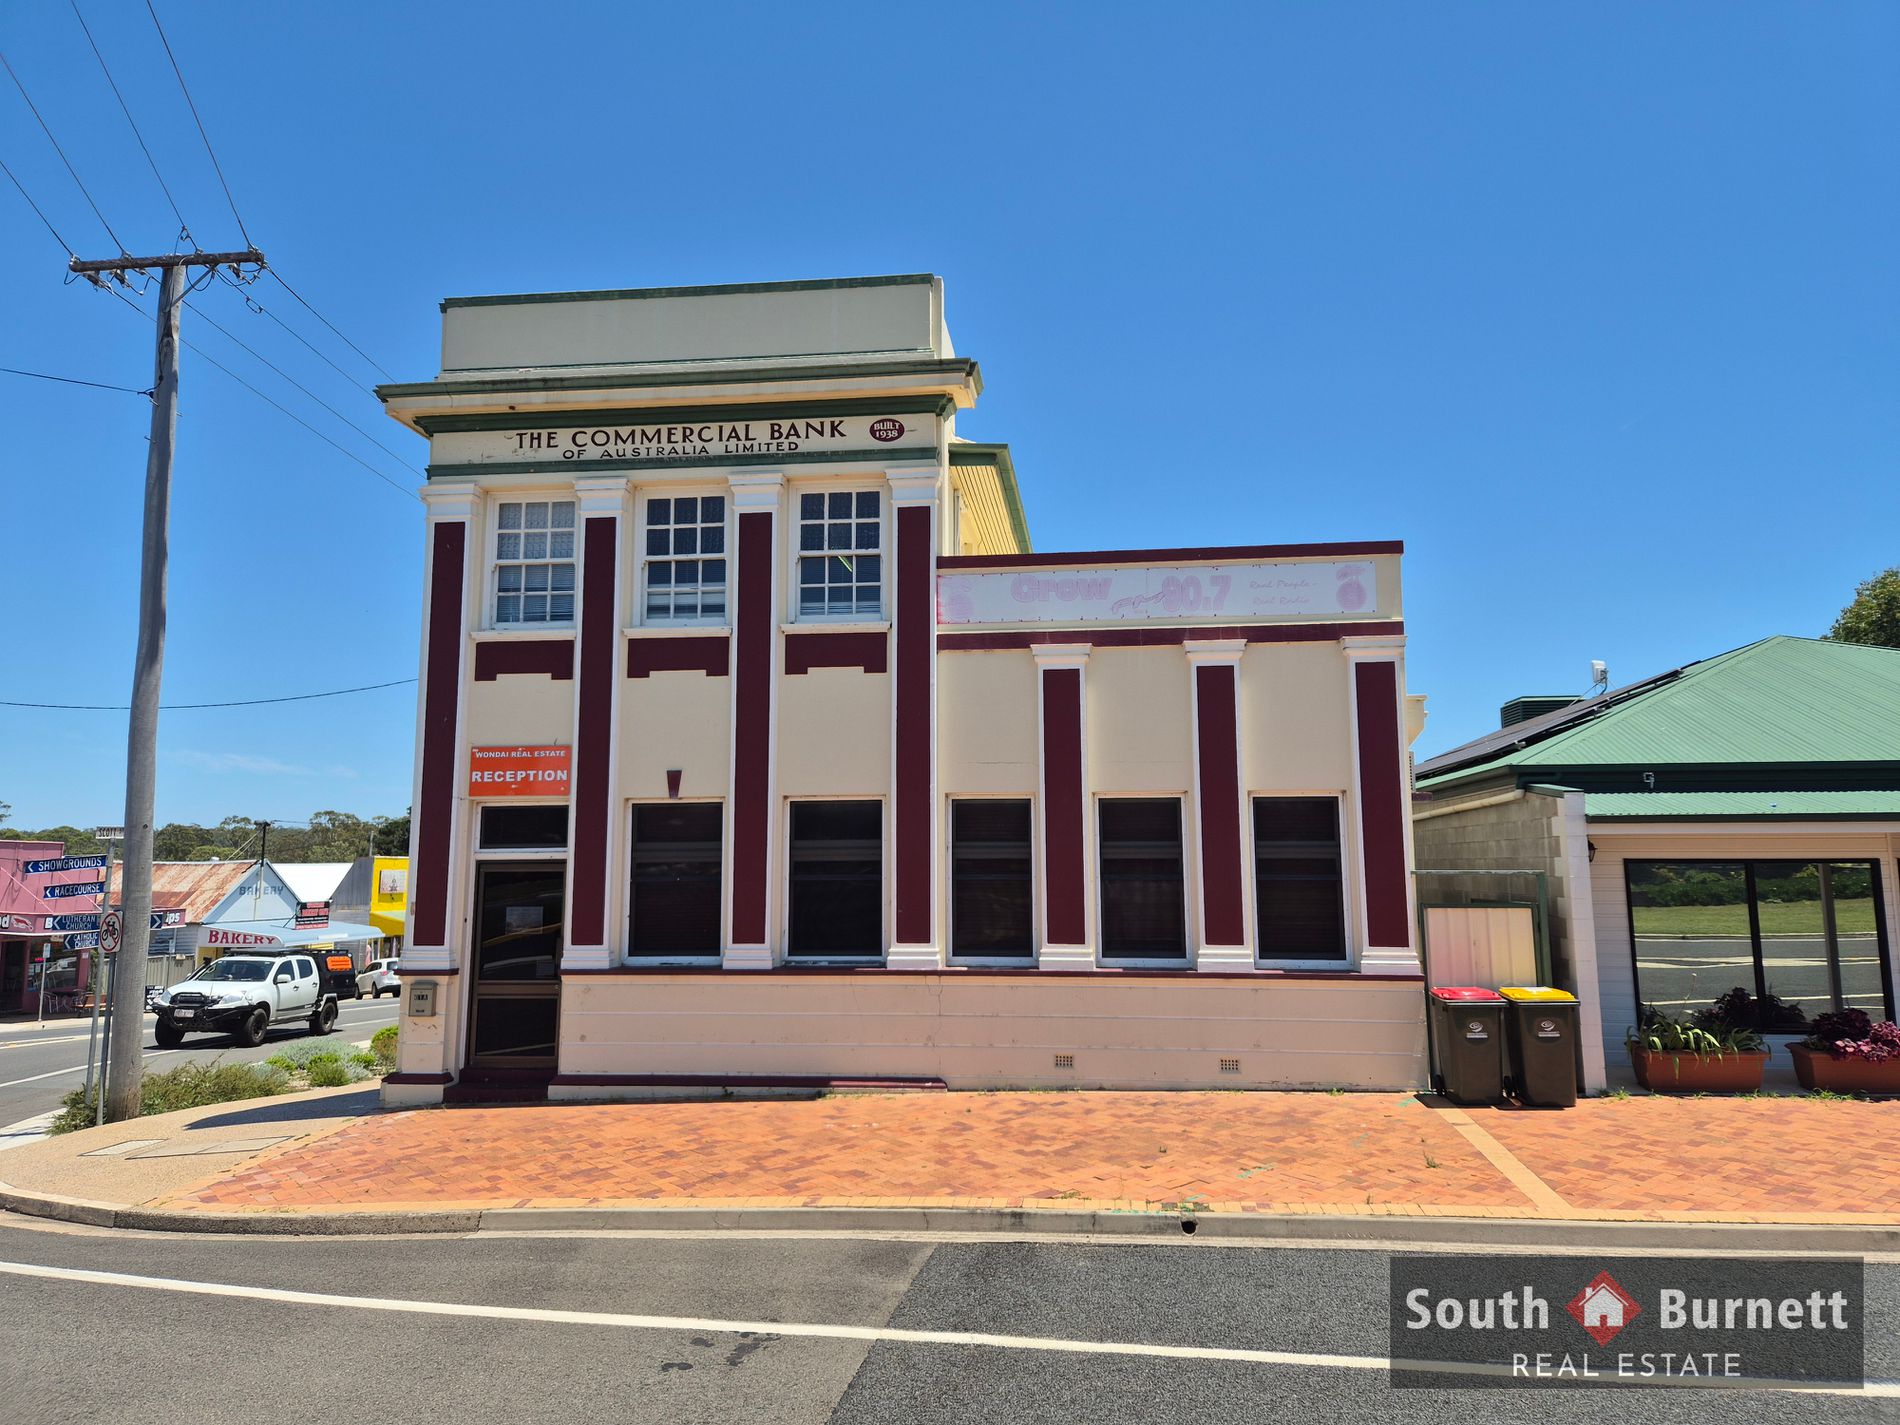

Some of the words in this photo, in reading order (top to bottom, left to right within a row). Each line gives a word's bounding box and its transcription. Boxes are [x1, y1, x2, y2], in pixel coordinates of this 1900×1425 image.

[874, 421, 900, 430] BUILT
[516, 432, 559, 449] THE
[571, 423, 757, 448] COMMERCIAL
[769, 420, 847, 440] BANK
[876, 430, 898, 439] 1938
[562, 449, 587, 460] OF
[600, 445, 710, 459] AUSTRALIA
[725, 441, 799, 454] LIMITED
[511, 750, 533, 758] REAL
[535, 750, 566, 758] ESTATE
[471, 769, 568, 782] RECEPTION
[38, 857, 102, 871] SHOWGROUNDS
[54, 883, 100, 894] RACECOURSE
[62, 915, 96, 923] LUTHERAN
[65, 922, 92, 930] CHURCH
[74, 933, 98, 941] CATHOLIC
[208, 930, 275, 945] BAKERY
[74, 940, 96, 949] CHURCH
